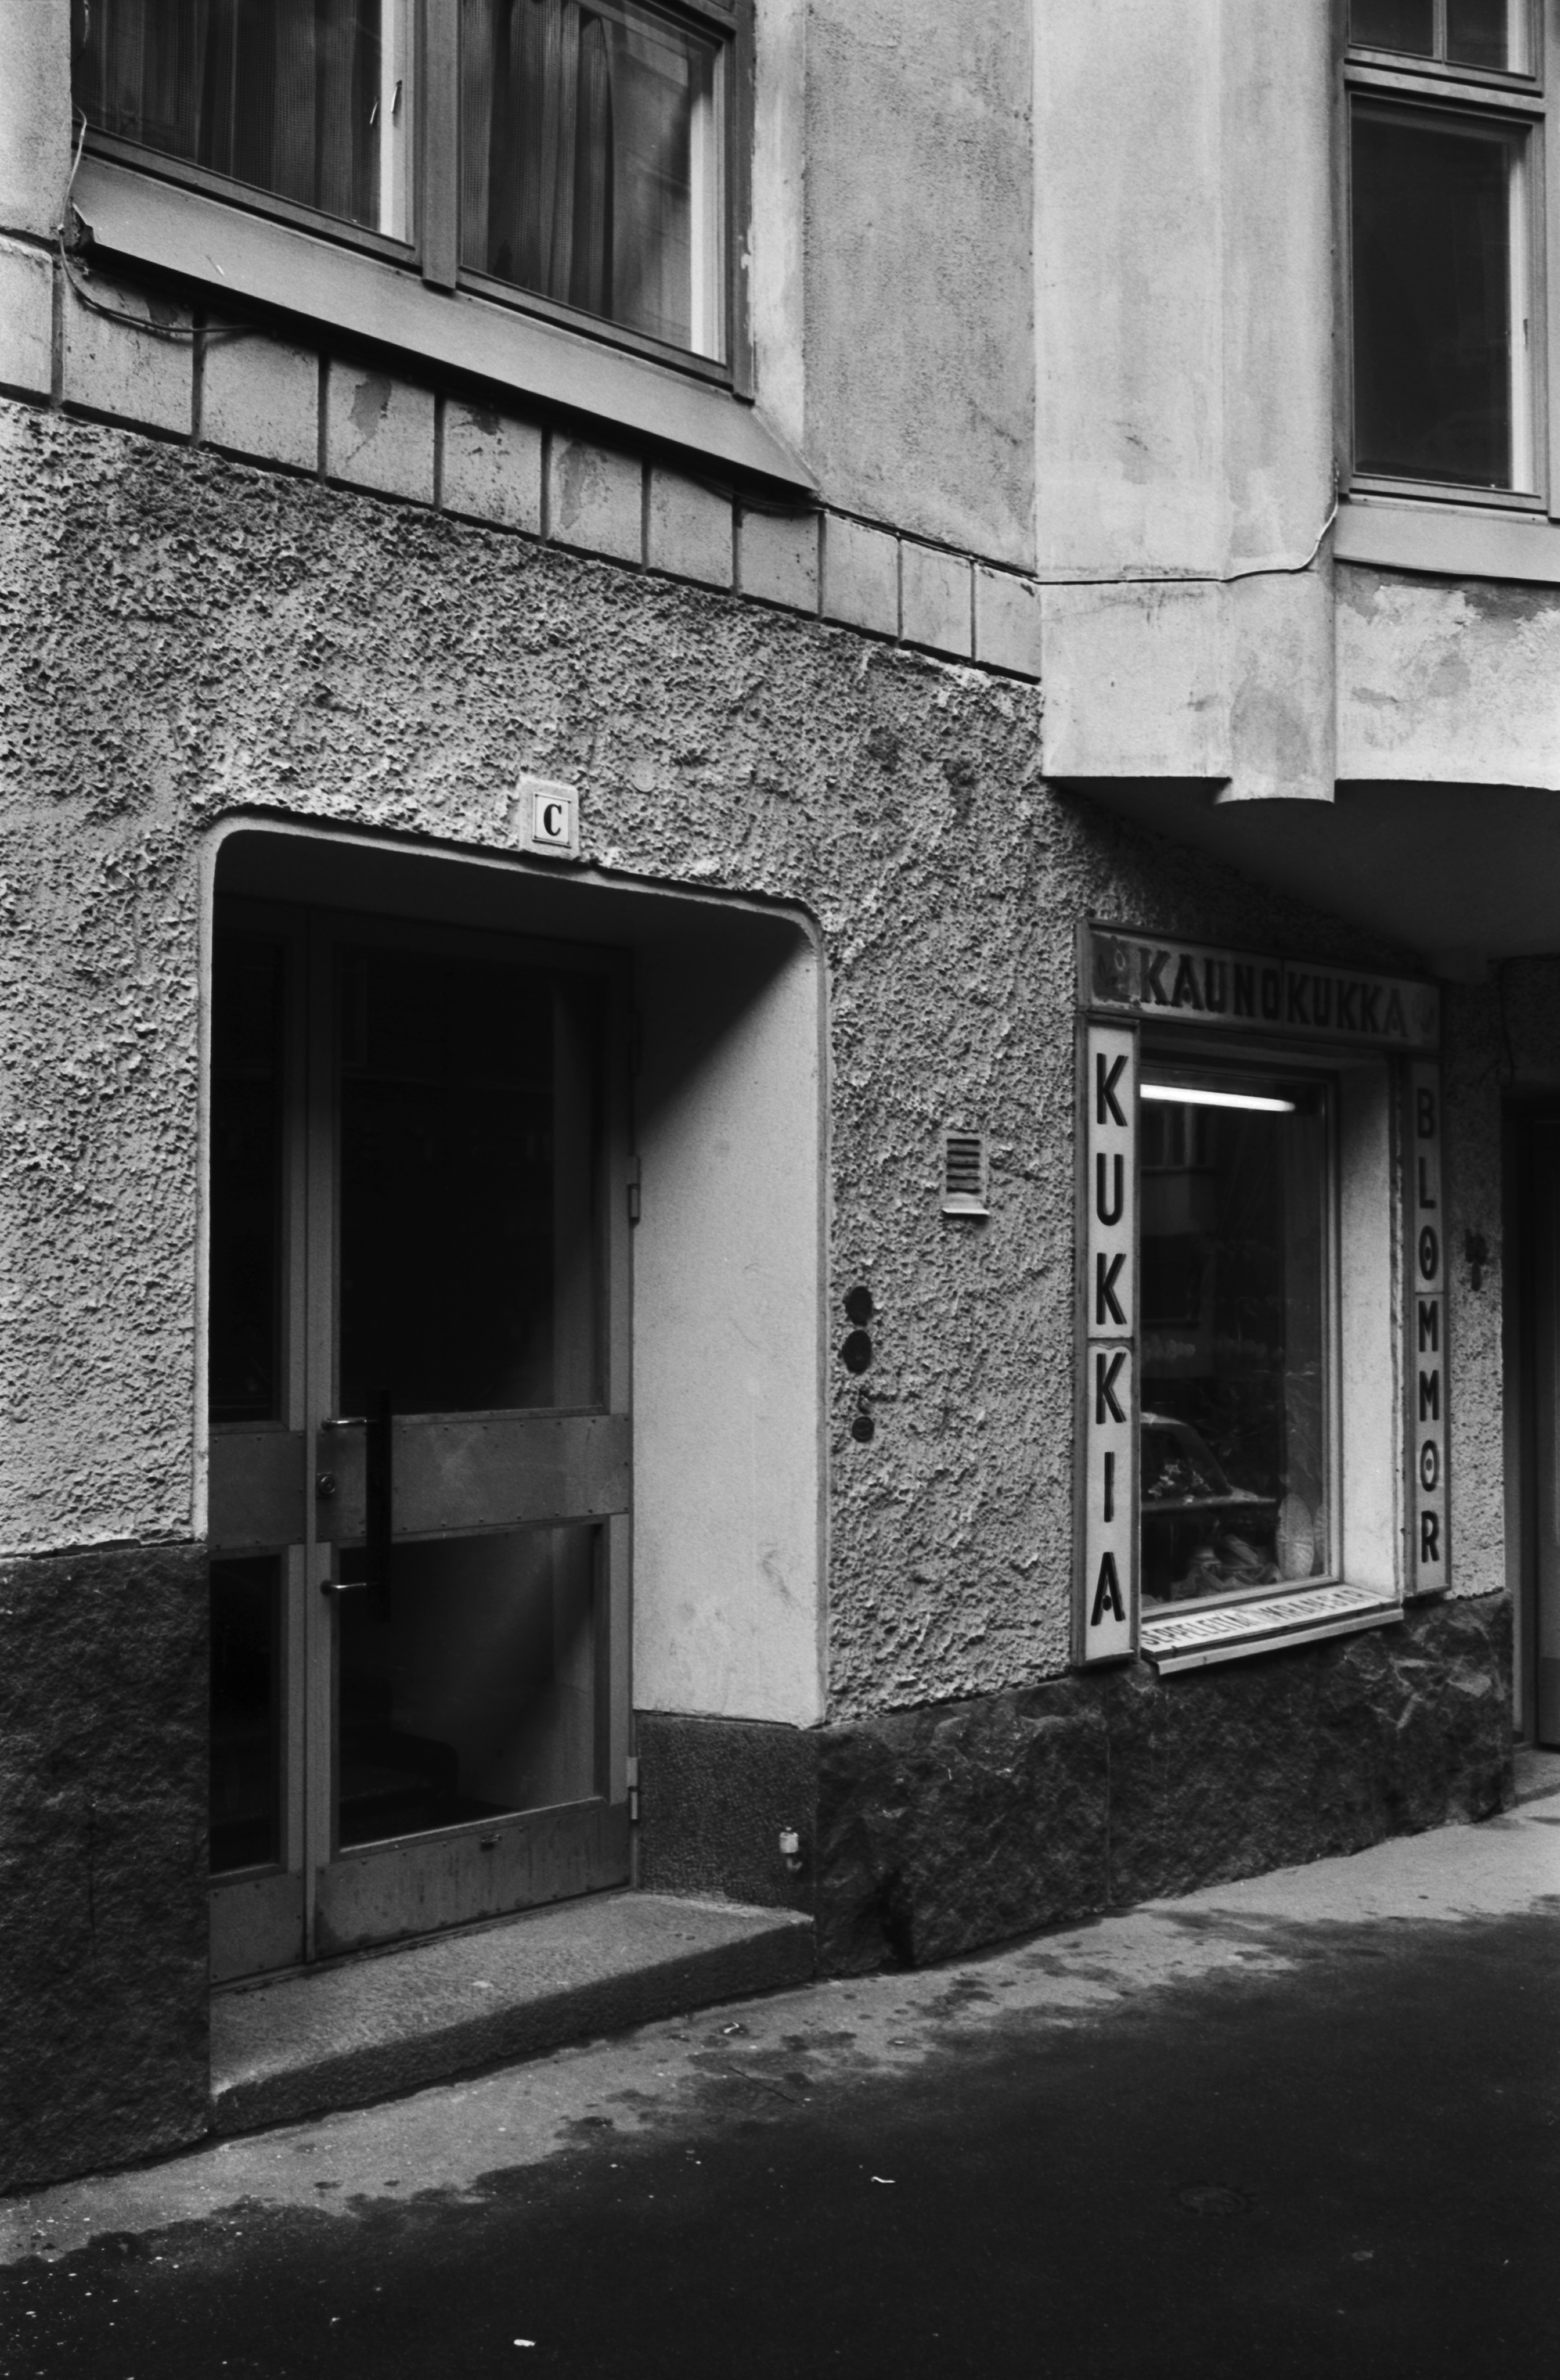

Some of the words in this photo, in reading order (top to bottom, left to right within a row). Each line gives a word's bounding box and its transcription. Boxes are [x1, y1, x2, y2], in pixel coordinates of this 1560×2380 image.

[543, 804, 561, 836] C
[1138, 948, 1407, 1037] KAUNOKUKKA
[1091, 1053, 1127, 1626] KUKKIA
[1417, 1088, 1439, 1562] BLOMMOR
